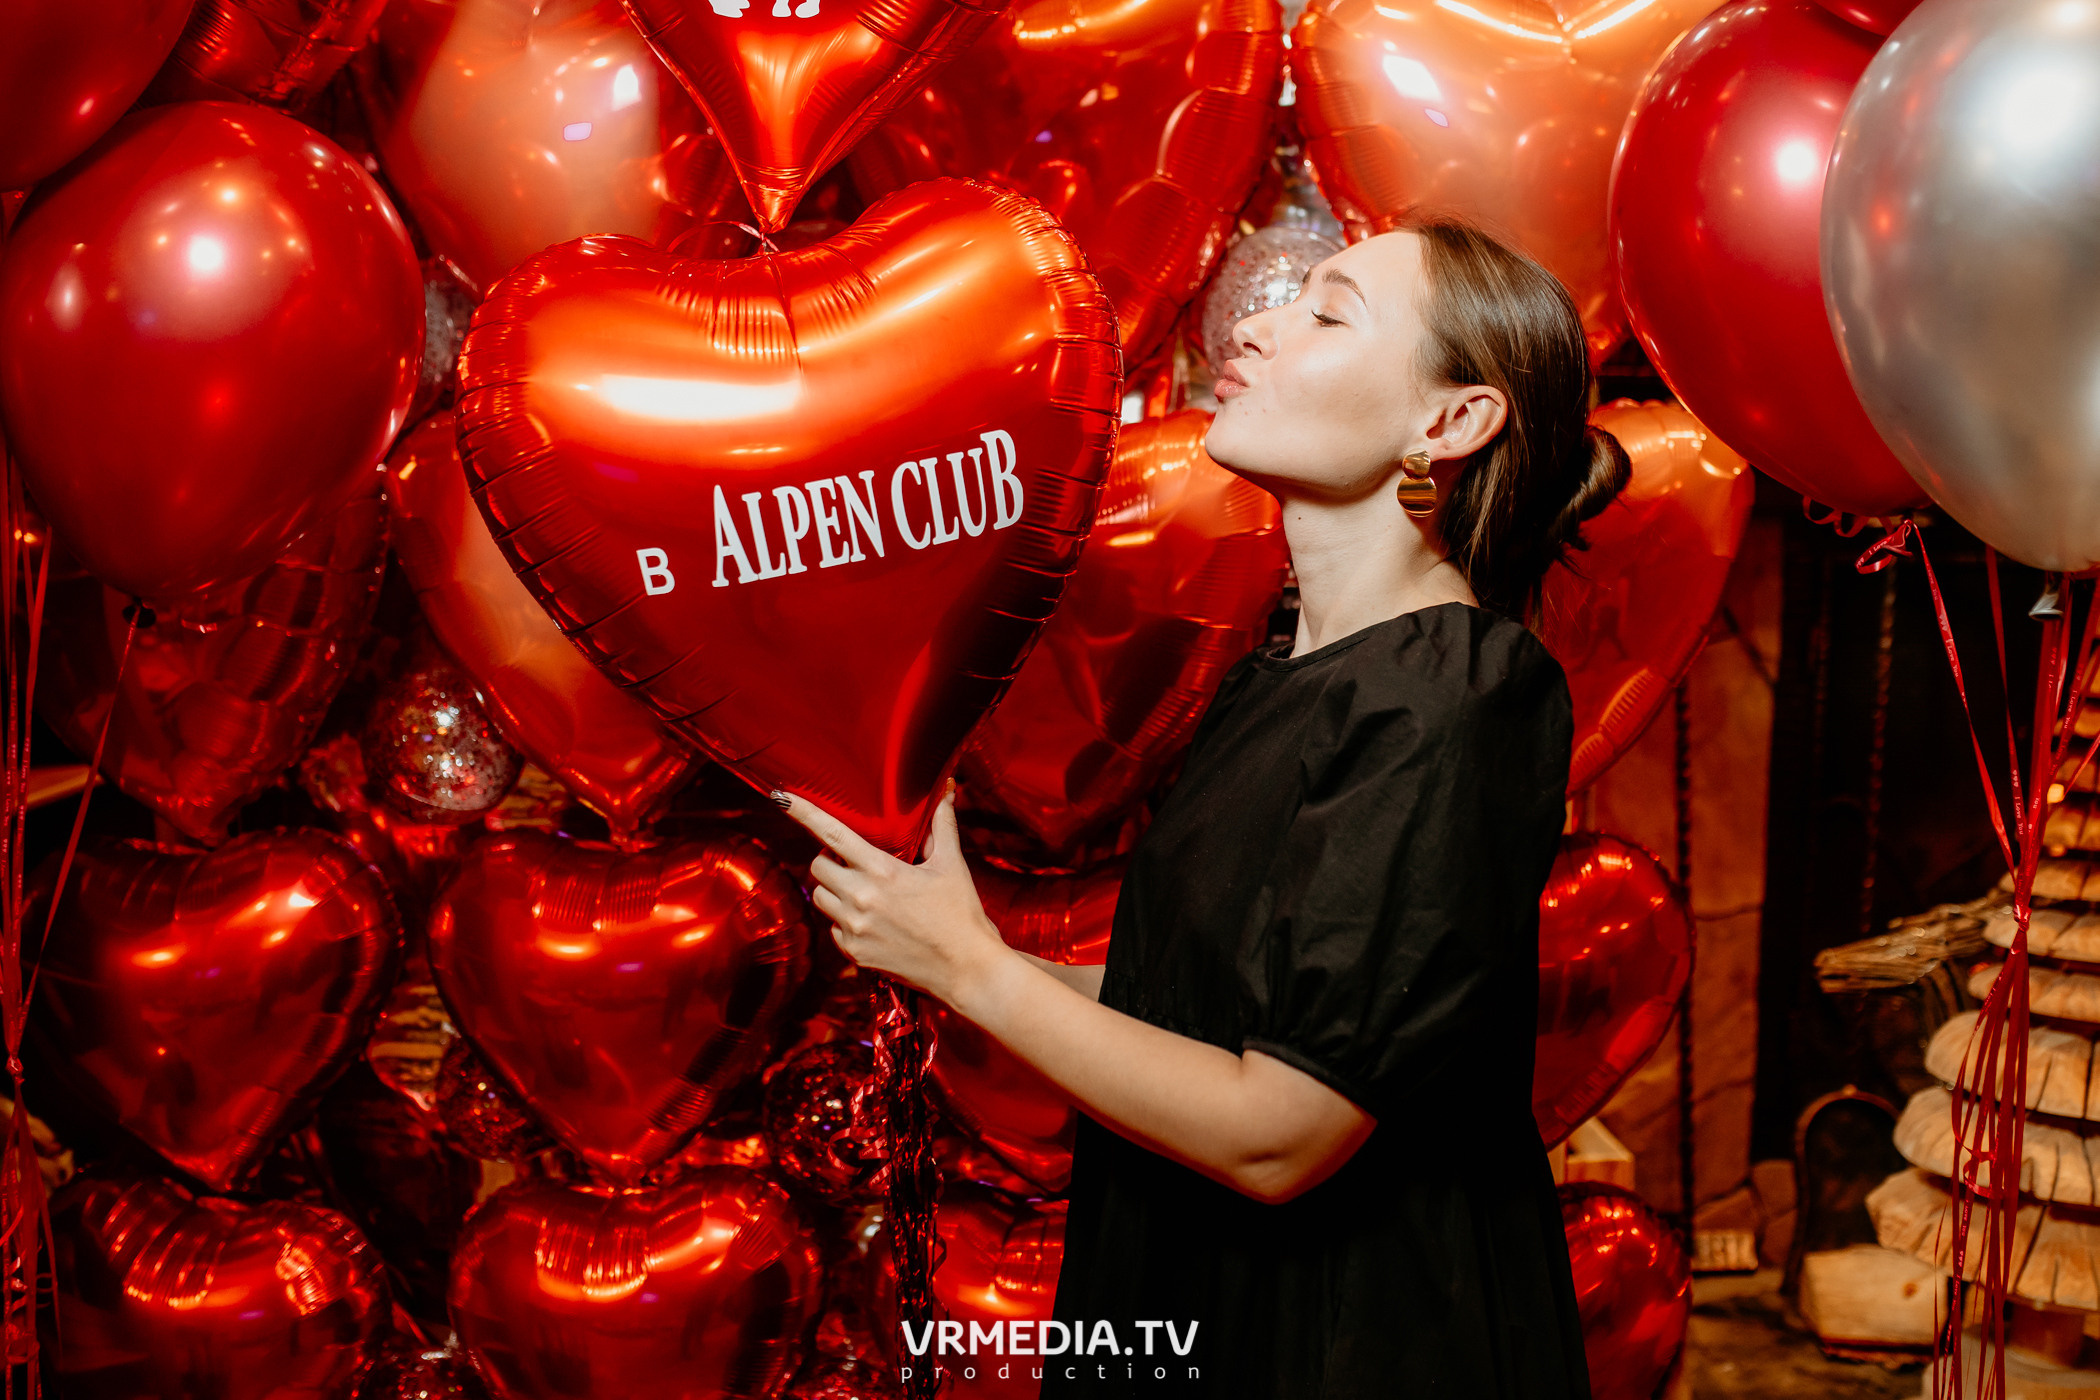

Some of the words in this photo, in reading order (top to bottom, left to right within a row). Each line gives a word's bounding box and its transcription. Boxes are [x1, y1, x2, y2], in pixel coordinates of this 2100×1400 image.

[711, 470, 885, 588] ALPEN
[891, 429, 1024, 550] CLUB
[1947, 645, 1955, 661] Love
[2067, 696, 2075, 712] Love
[2063, 717, 2071, 729] You
